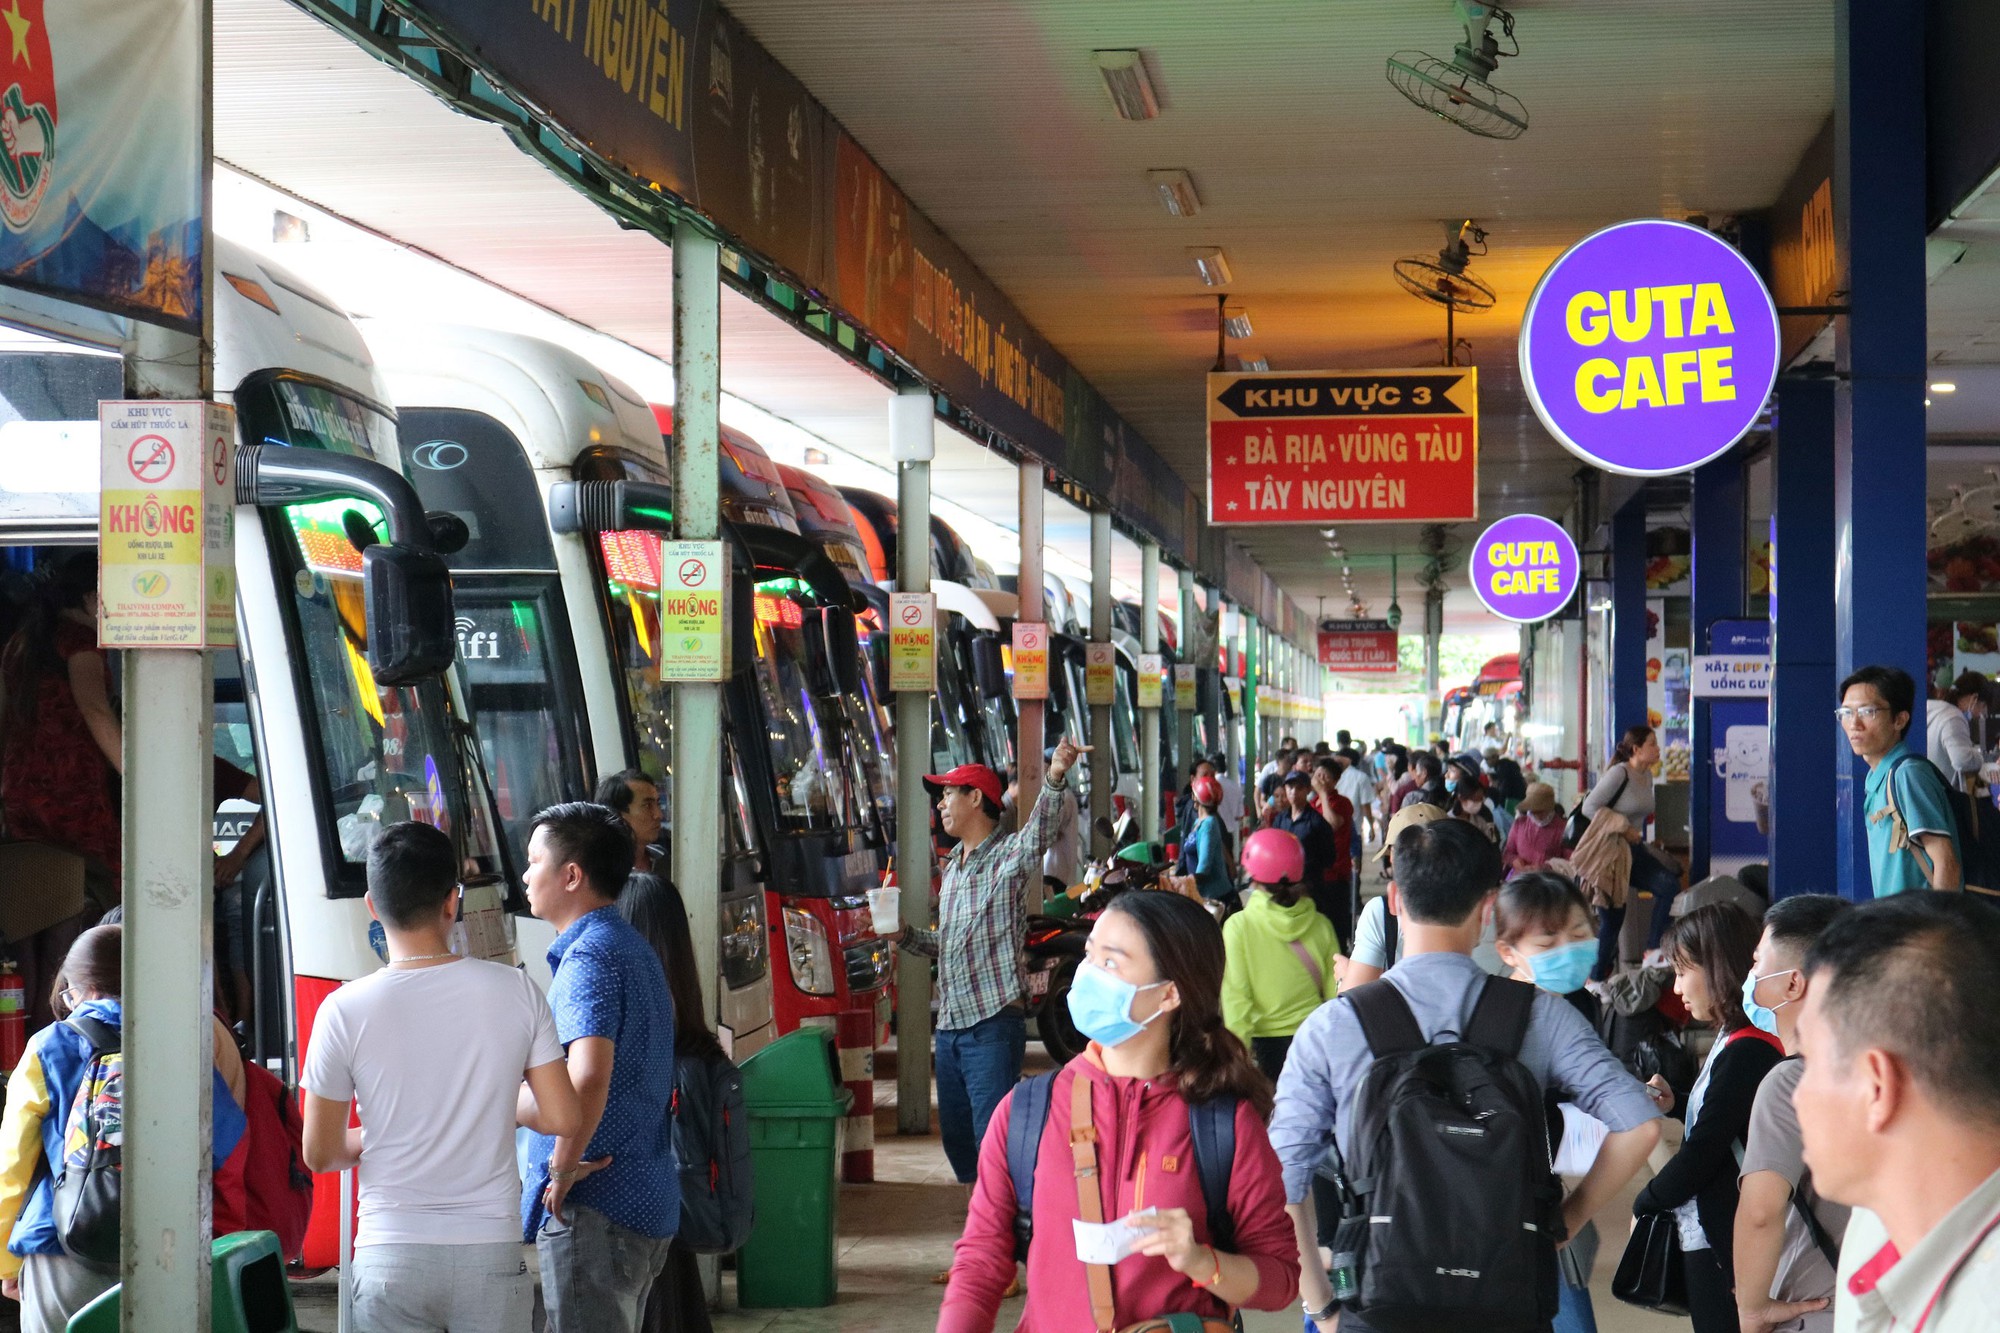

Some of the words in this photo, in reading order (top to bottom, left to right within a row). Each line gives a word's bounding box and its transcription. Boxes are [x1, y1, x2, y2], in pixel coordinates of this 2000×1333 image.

[1565, 282, 1735, 347] GUTA
[1574, 346, 1737, 414] CAFE
[1245, 388, 1318, 408] KHU
[1330, 383, 1401, 411] VỰC
[1412, 386, 1432, 405] 3
[127, 408, 149, 417] KHU
[152, 407, 172, 418] VỰC
[1245, 427, 1278, 464] BÀ
[1415, 424, 1463, 462] TÀU
[1245, 474, 1292, 511] TÂY
[1302, 472, 1406, 509] NGUYÊN
[109, 493, 194, 537] KHÔNG
[1488, 541, 1560, 567] GUTA
[1490, 568, 1560, 596] CAFE
[151, 603, 185, 611] COMPANY
[668, 592, 718, 618] KHÔNG
[458, 631, 500, 659] ifi
[894, 628, 930, 647] KHÔNG
[1711, 673, 1746, 689] UỐNG
[1733, 662, 1762, 673] APP
